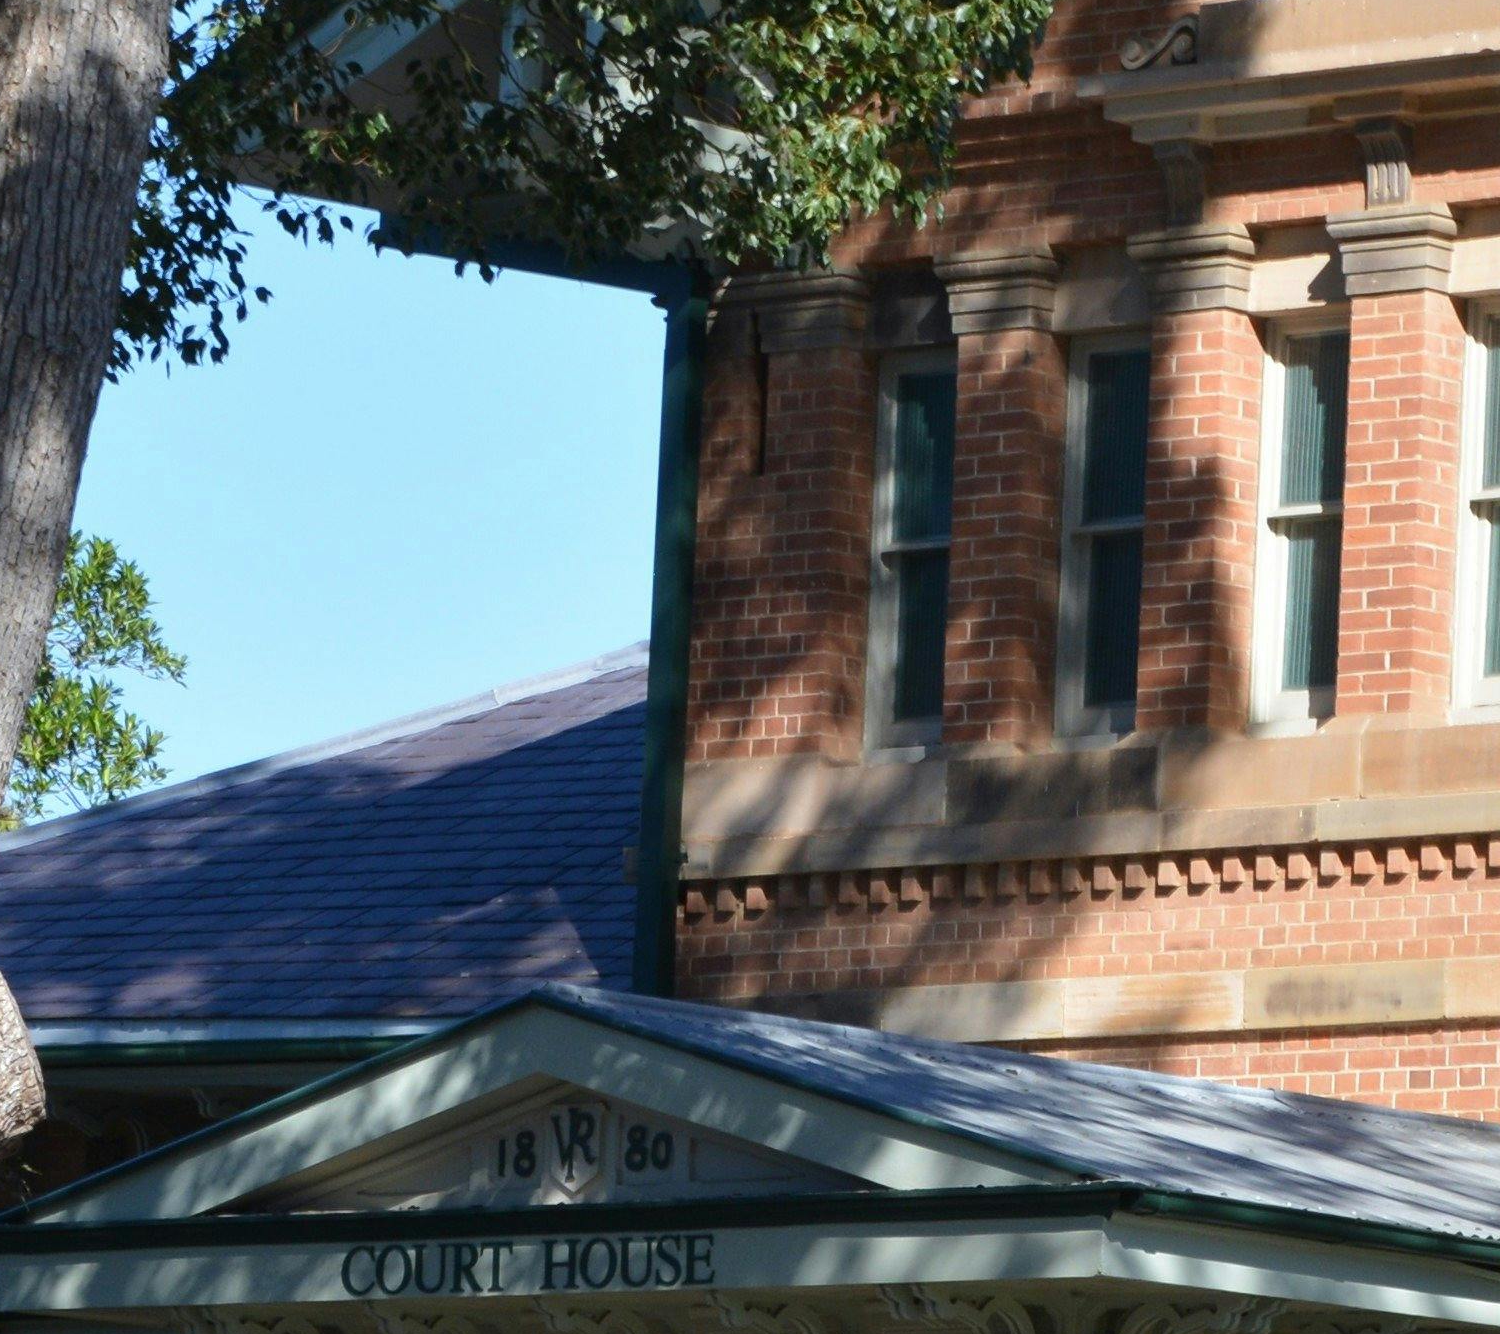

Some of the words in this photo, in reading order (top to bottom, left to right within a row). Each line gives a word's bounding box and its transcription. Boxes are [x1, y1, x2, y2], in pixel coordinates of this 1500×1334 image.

[498, 1130, 536, 1178] 18
[625, 1124, 674, 1171] 80
[341, 1241, 514, 1297] COURT
[540, 1233, 715, 1290] HOUSE
